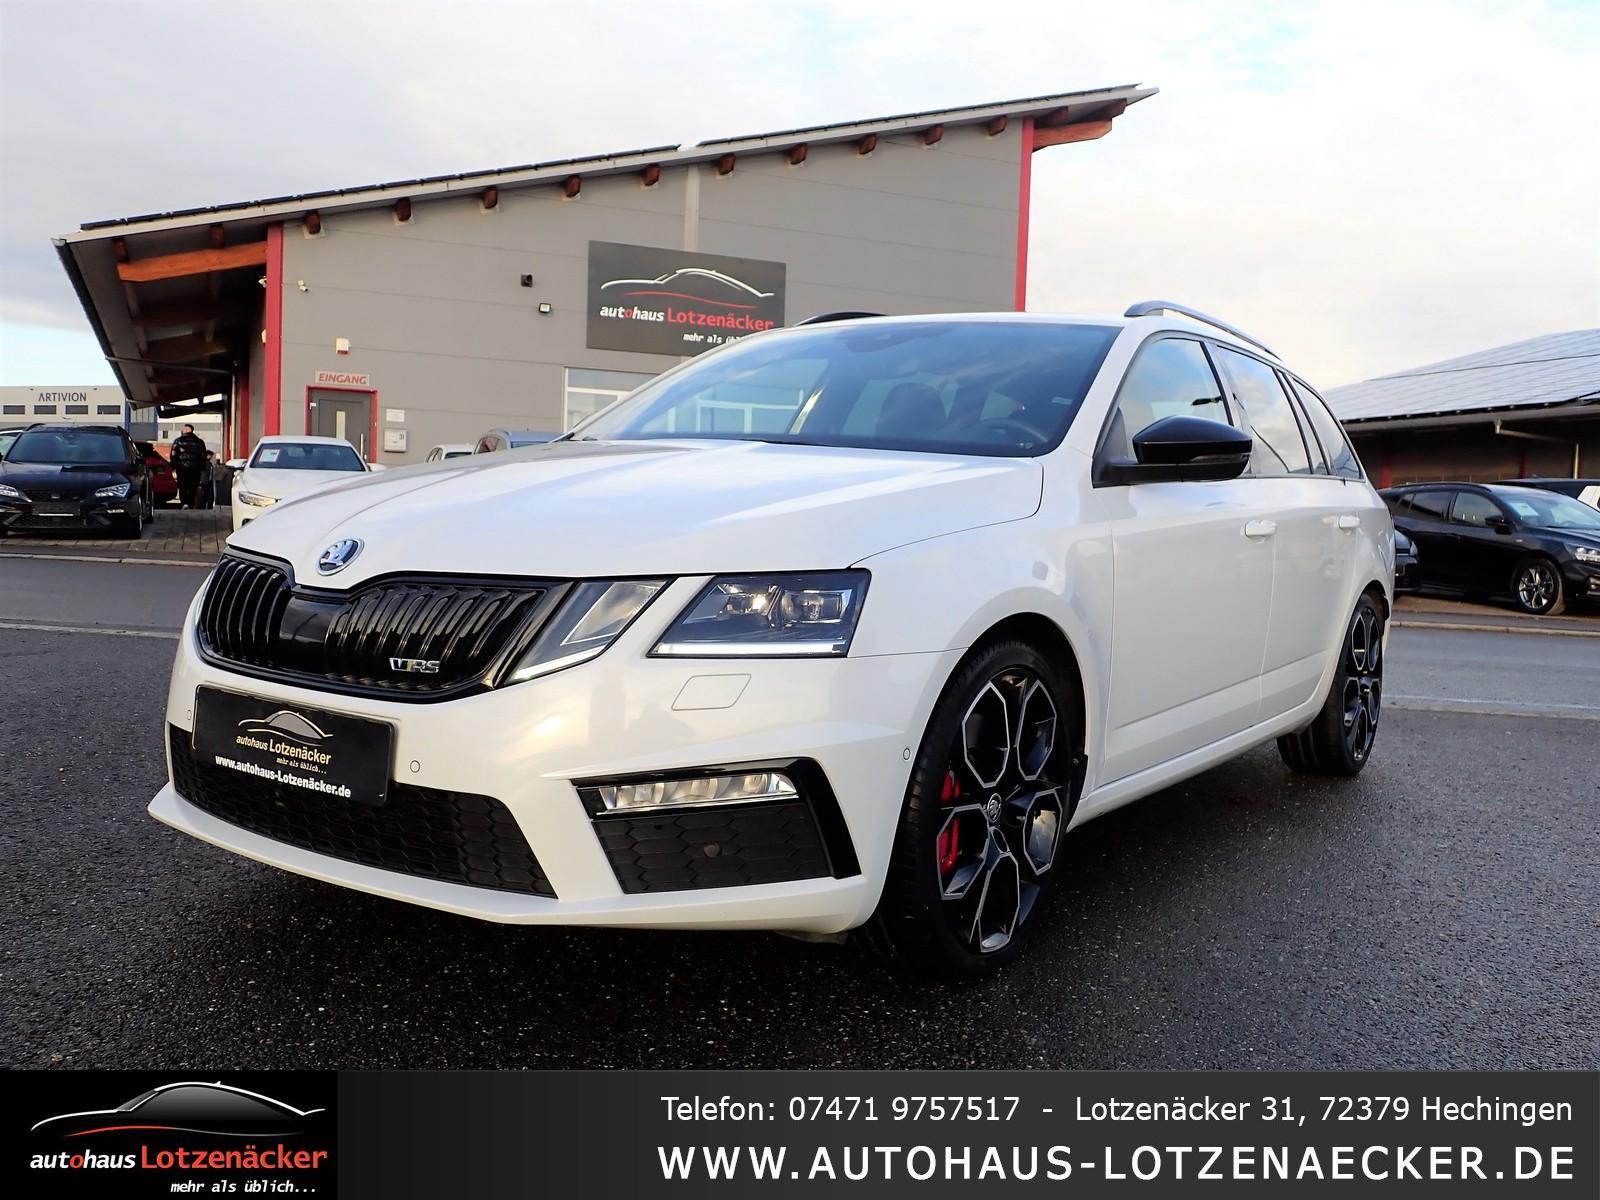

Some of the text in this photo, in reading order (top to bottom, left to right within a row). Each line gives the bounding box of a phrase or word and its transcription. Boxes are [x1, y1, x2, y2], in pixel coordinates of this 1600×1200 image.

[600, 306, 774, 331] autohaus Lotzenäcker
[683, 333, 704, 342] mehr
[707, 334, 722, 344] als
[319, 373, 367, 385] EINGANG
[38, 392, 87, 402] ARTIVION
[236, 735, 332, 765] autohaus Lotzenäcker
[215, 755, 351, 798] www.autohaus-Lotzenäcker.de
